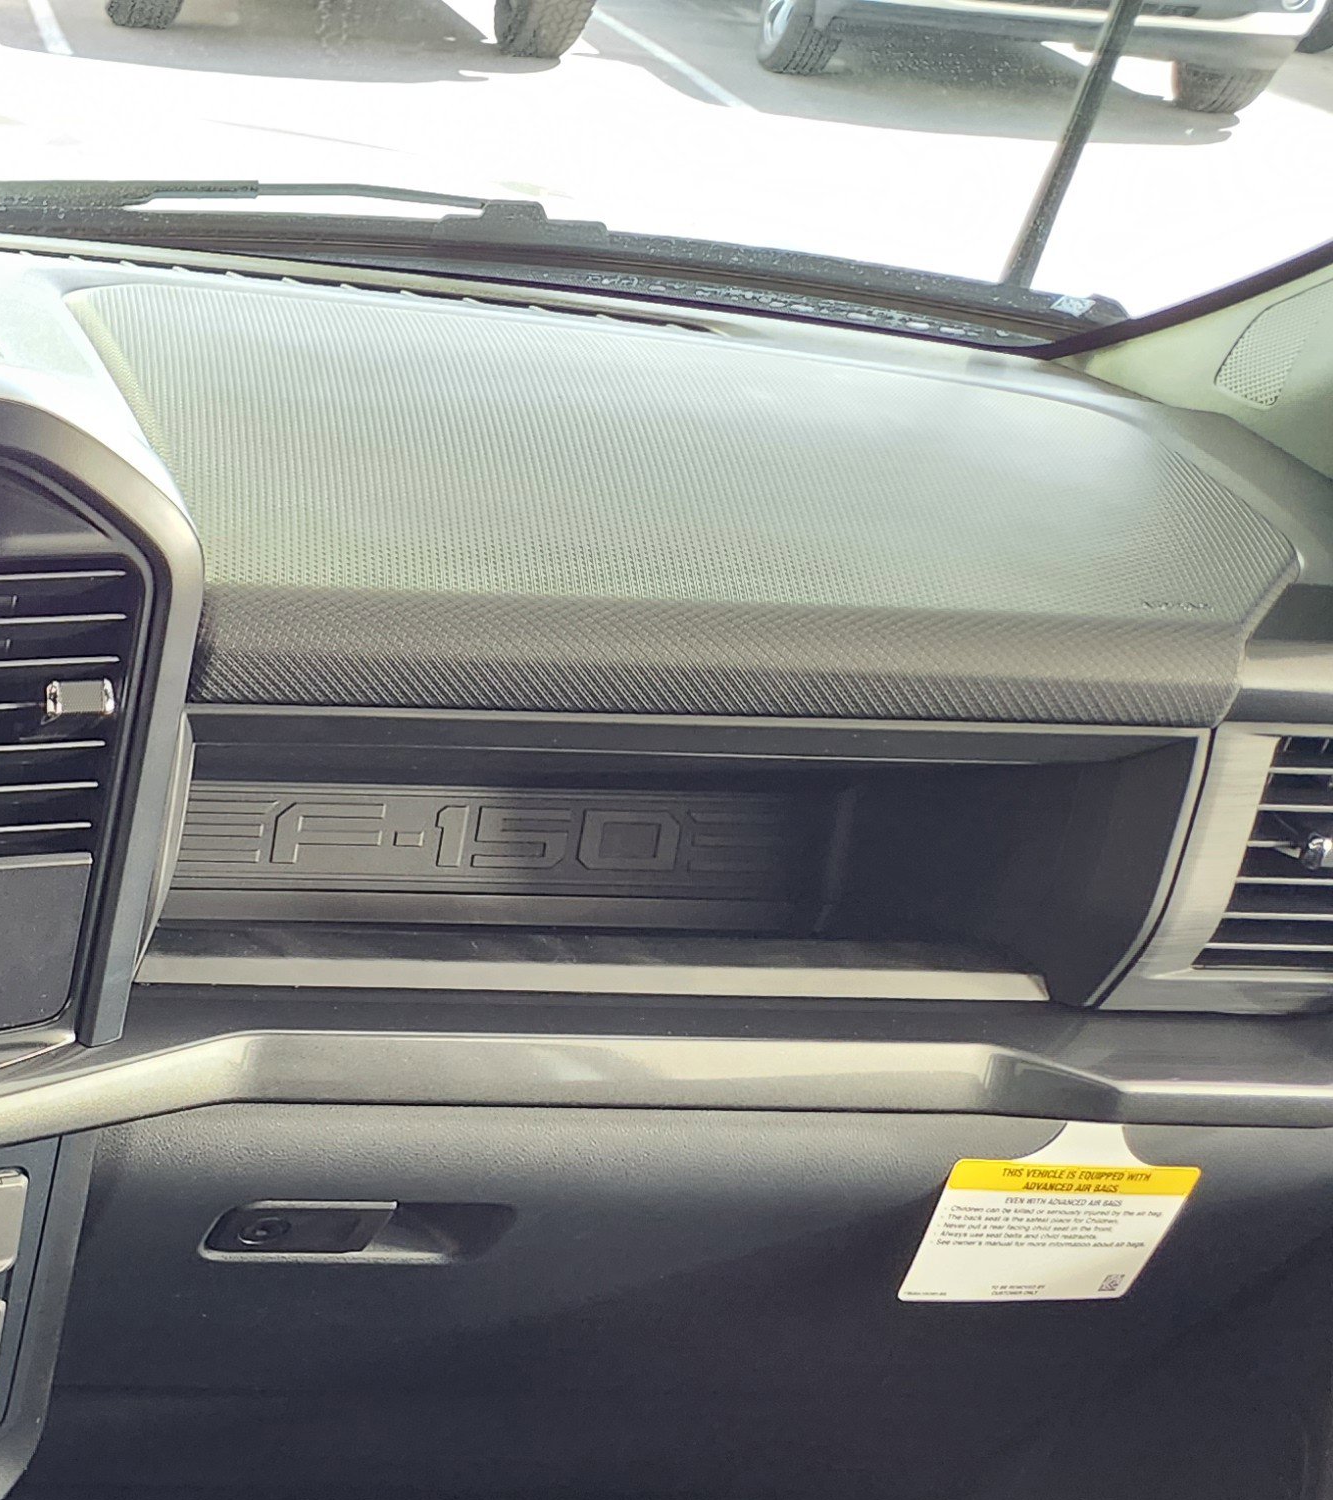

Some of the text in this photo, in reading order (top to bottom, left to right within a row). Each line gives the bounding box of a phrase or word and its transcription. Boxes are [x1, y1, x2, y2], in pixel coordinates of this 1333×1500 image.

[270, 802, 683, 872] F-150
[1002, 1168, 1152, 1181] THIS VEHICLE IS EQUIPPED WITH
[1022, 1181, 1119, 1193] ADVANCED AIR BAGS
[1048, 1198, 1087, 1206] ADVANCED
